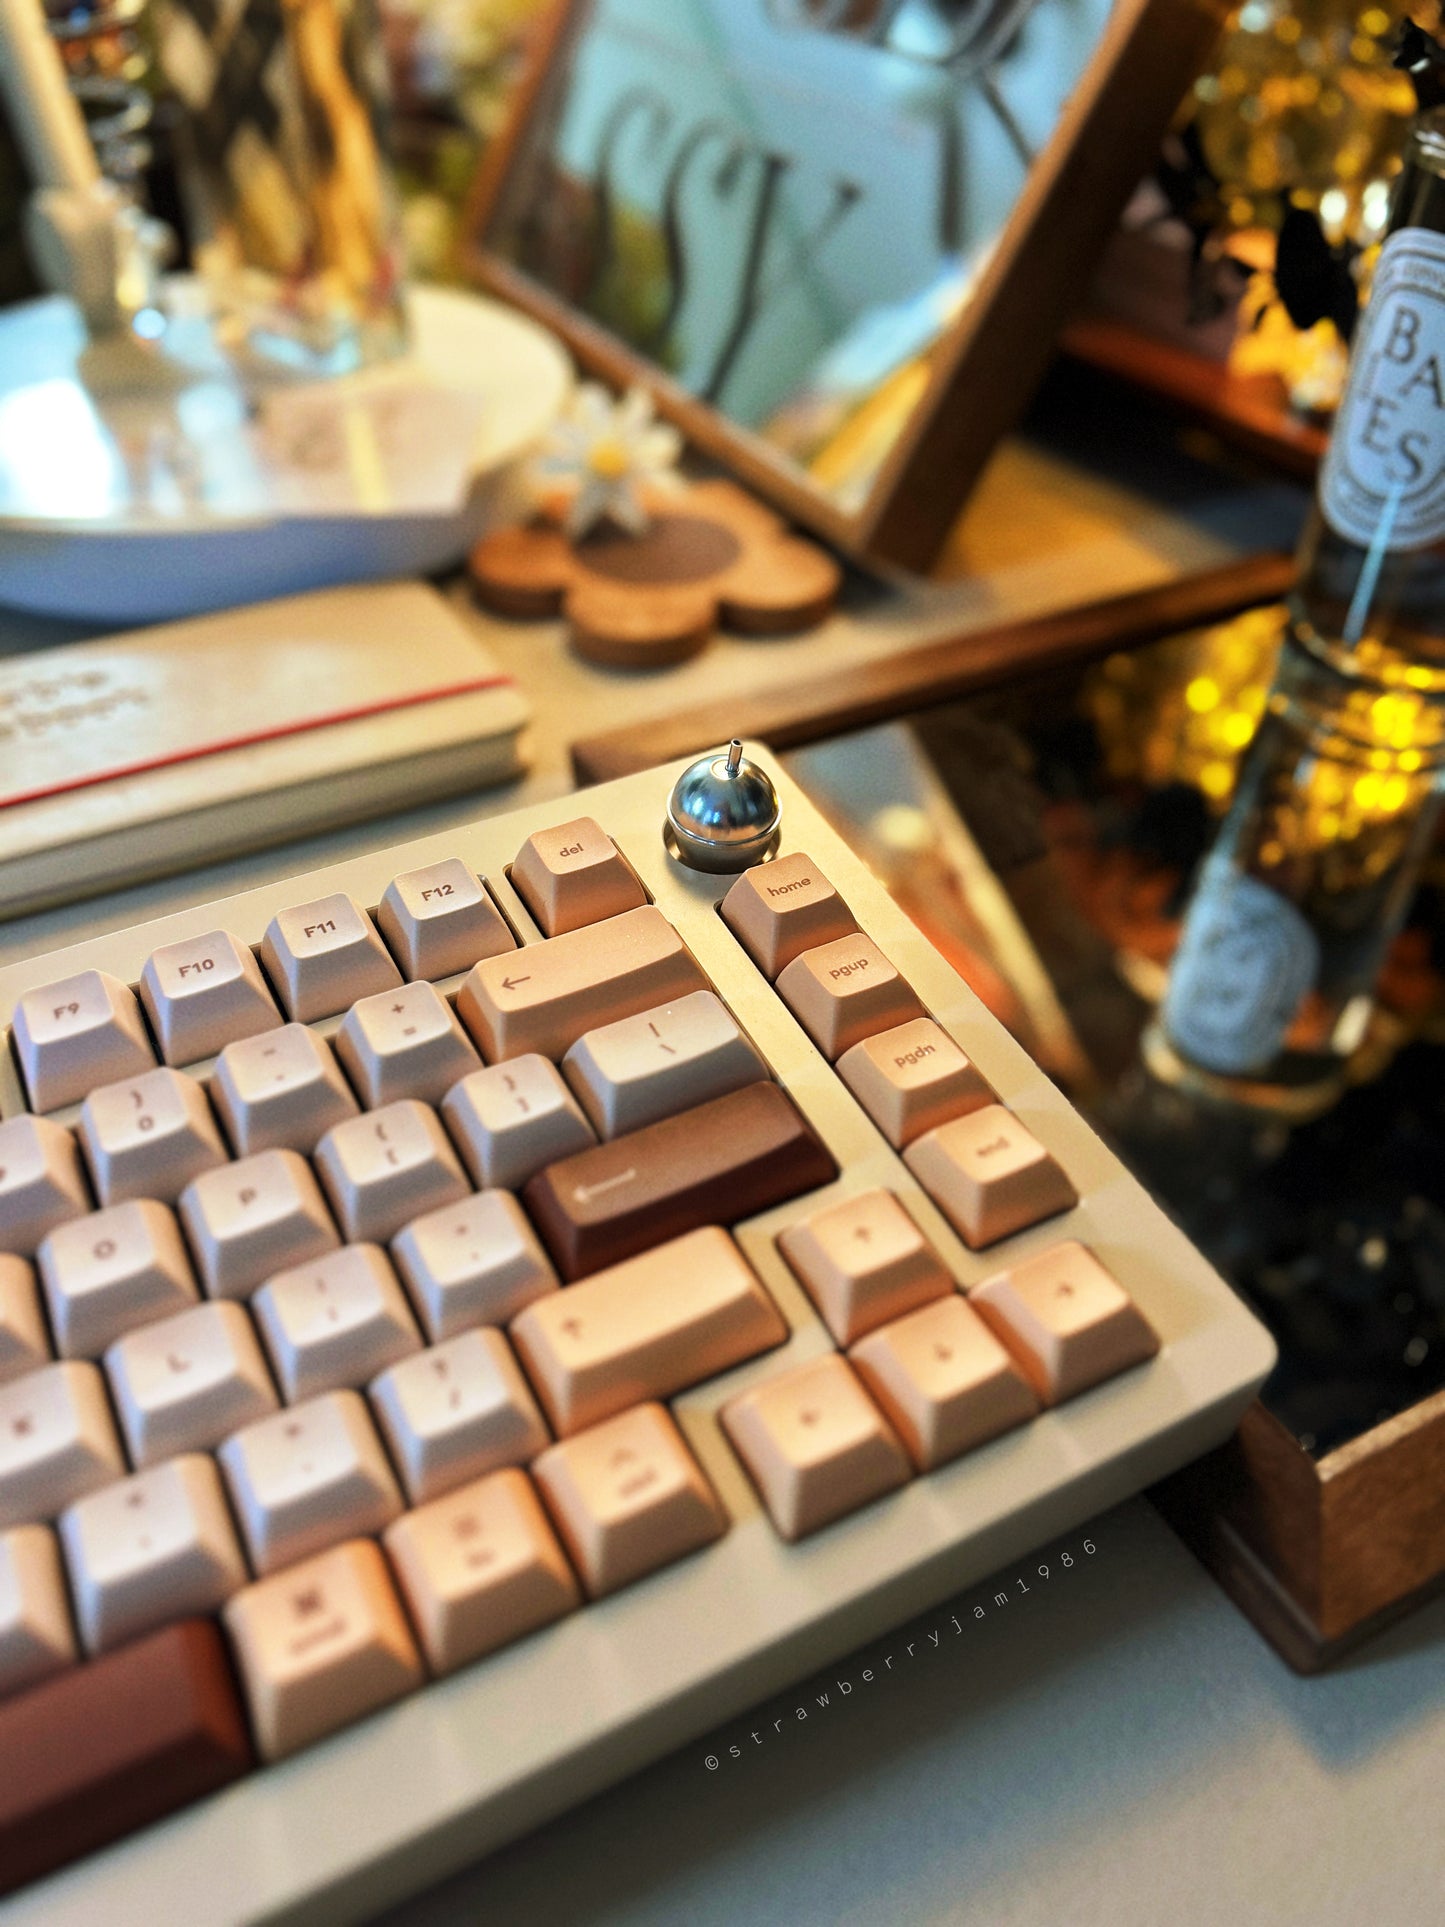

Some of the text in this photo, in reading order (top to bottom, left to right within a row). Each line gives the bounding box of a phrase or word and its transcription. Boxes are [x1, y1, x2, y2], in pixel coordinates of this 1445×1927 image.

[558, 842, 585, 858] del
[421, 883, 455, 902] F12
[766, 875, 812, 897] home
[303, 919, 337, 938] F11
[178, 958, 216, 978] F10
[828, 957, 869, 980] pgup
[53, 1002, 81, 1020] F9
[894, 1043, 936, 1069] pgdn
